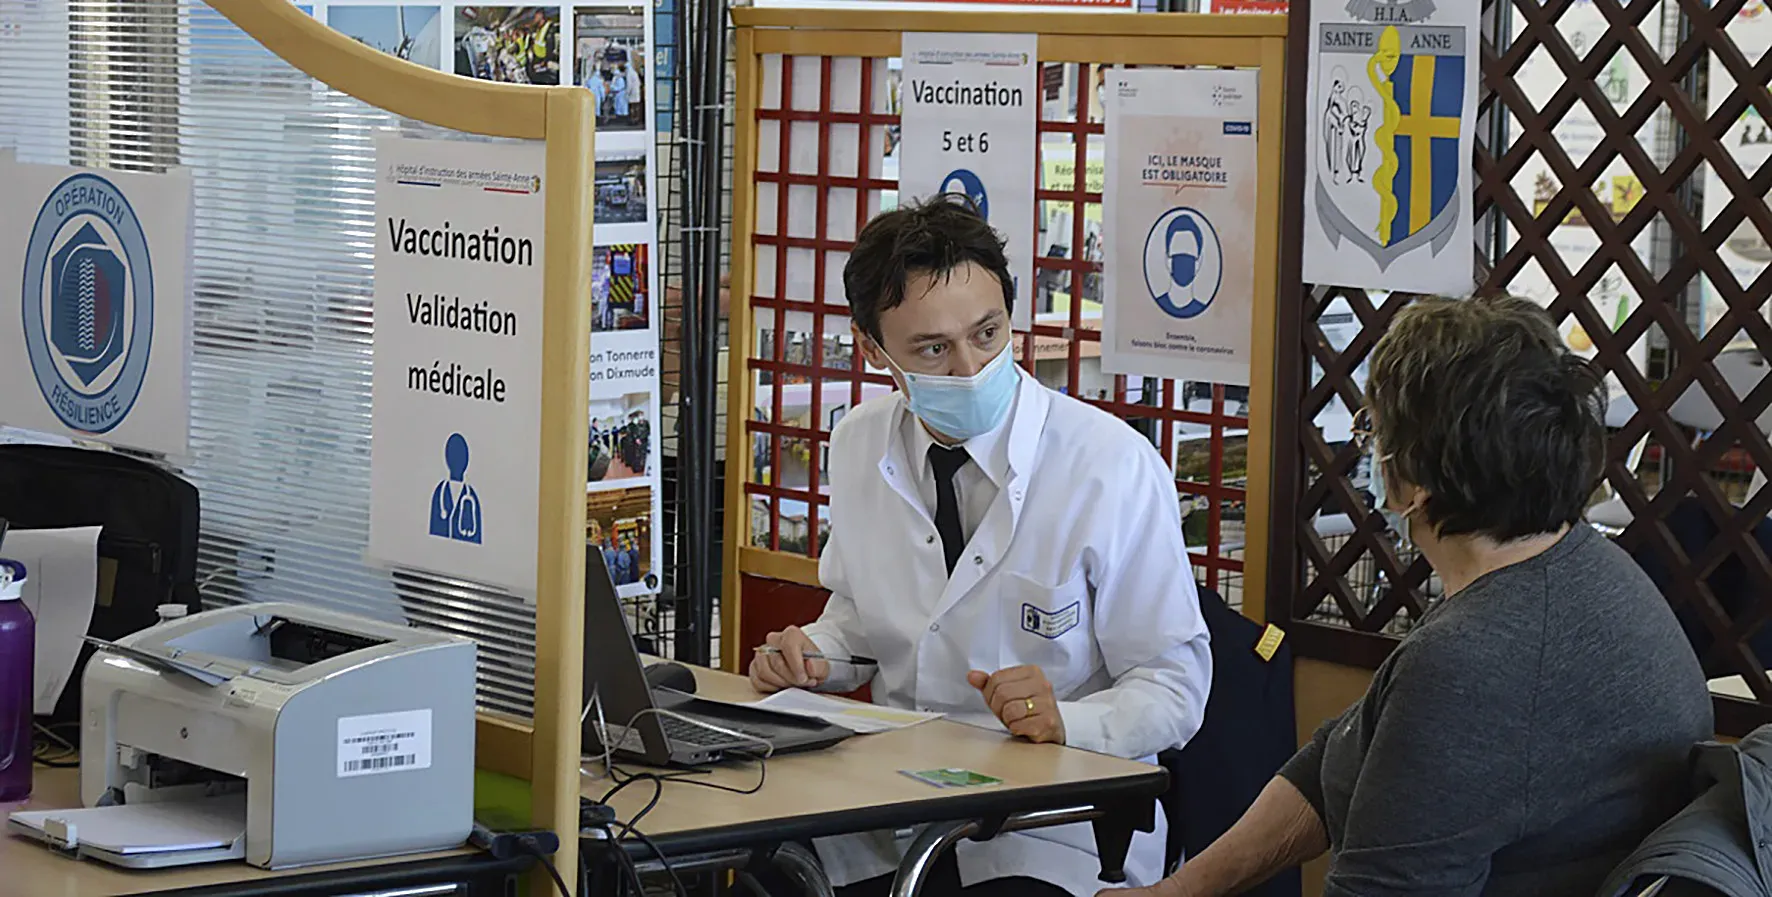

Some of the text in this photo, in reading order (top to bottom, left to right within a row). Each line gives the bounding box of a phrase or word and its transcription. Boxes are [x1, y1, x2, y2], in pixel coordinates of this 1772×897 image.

[1325, 31, 1451, 49] SAINTE ANNE
[912, 80, 1022, 107] Vaccination
[942, 131, 989, 153] 5 et 6
[1148, 155, 1222, 169] ICI, LE MASQUE
[1142, 169, 1228, 183] EST OBLIGATOIRE
[55, 184, 124, 225] OPÉRATION
[388, 217, 532, 266] Vaccination
[406, 293, 516, 336] Validation
[606, 350, 655, 362] Tonnerre
[408, 360, 506, 402] médicale
[606, 365, 655, 380] Dixmude
[51, 383, 121, 424] RÉSILIENCE
